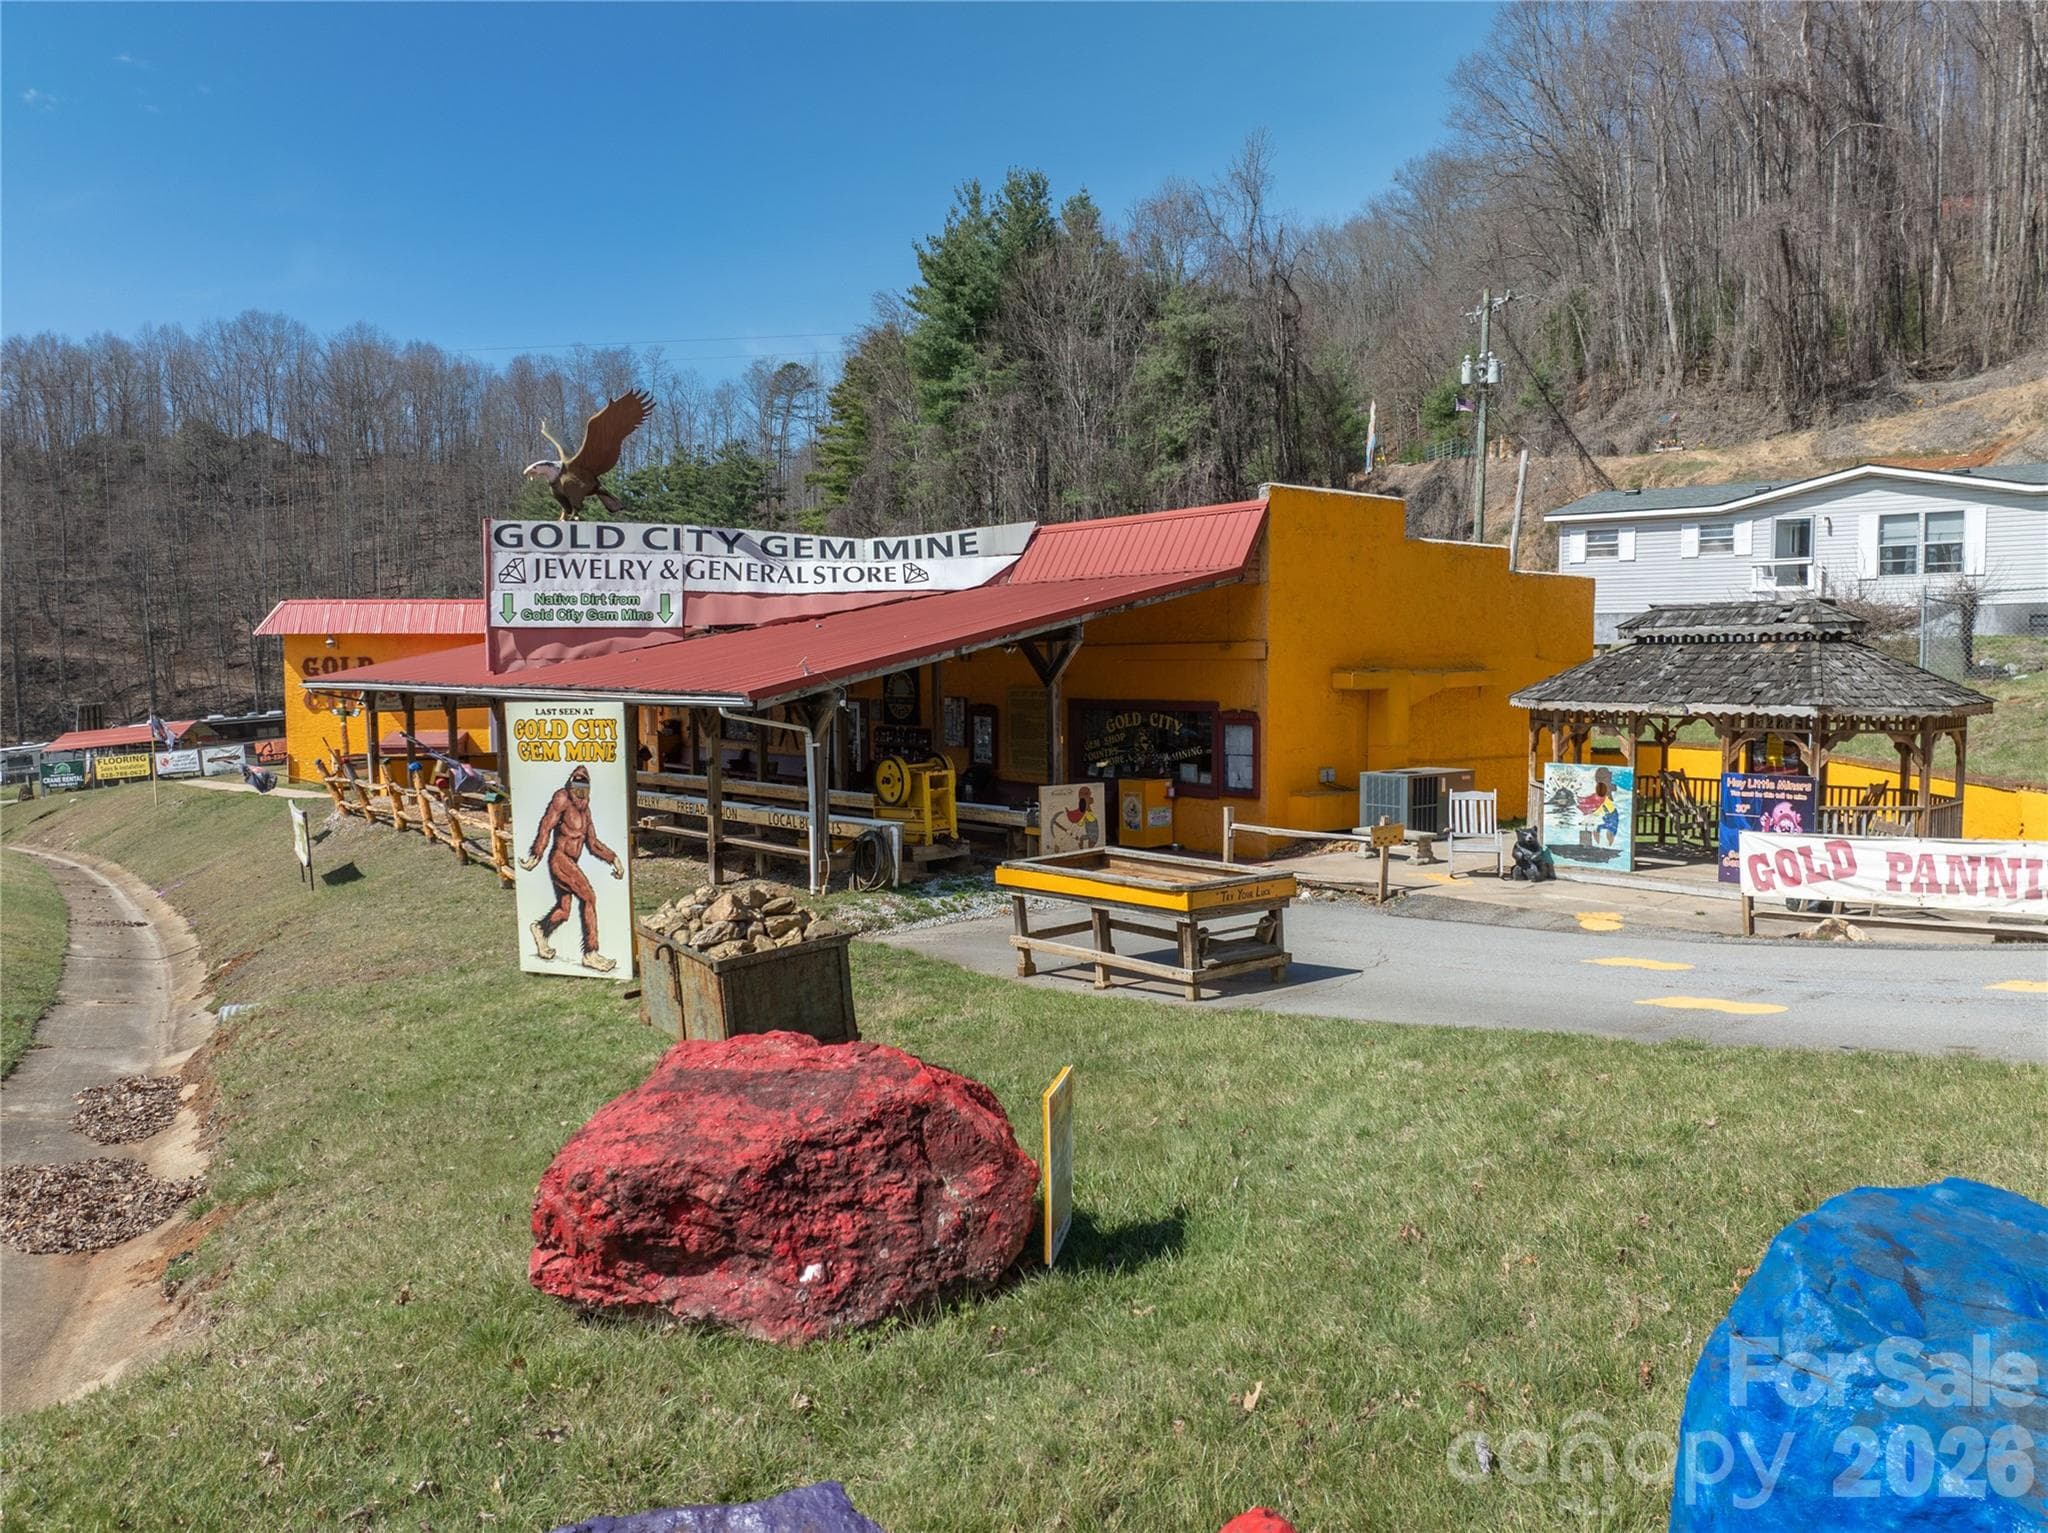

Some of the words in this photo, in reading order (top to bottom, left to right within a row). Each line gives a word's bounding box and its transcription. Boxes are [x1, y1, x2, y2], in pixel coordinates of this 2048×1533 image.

[494, 523, 626, 549] GOLD
[642, 527, 745, 554] CITY
[760, 535, 856, 559] GEM
[873, 531, 979, 560] MINE
[533, 558, 653, 583] JEWELRY
[660, 559, 680, 580] &
[685, 558, 809, 584] GENERAL
[813, 565, 897, 584] STORE
[534, 592, 576, 606] Native
[580, 592, 607, 605] Dirt
[608, 592, 641, 605] from
[520, 608, 554, 621] Gold
[556, 609, 584, 624] City
[585, 609, 618, 621] Gem
[620, 609, 654, 621] Mine
[535, 708, 557, 716] LAST
[559, 708, 581, 716] SEEN
[583, 708, 595, 716] AT
[514, 719, 568, 740] GOLD
[572, 718, 618, 740] CITY
[1106, 712, 1142, 733] GOLD
[1150, 712, 1183, 736] CITY
[1104, 733, 1126, 745] SHOP
[517, 741, 561, 762] GEM
[564, 741, 617, 762] MINE
[1171, 745, 1203, 761] MINING
[97, 754, 147, 766] FLOORING
[43, 776, 61, 784] CRANE
[62, 775, 84, 783] RENTAL
[1727, 777, 1747, 790] Hey
[1747, 778, 1776, 789] Little
[1776, 780, 1812, 792] Miners
[677, 801, 694, 815] FREE
[768, 812, 797, 828] LOCAL
[1747, 840, 1858, 892] GOLD
[1886, 852, 2048, 900] PANNI
